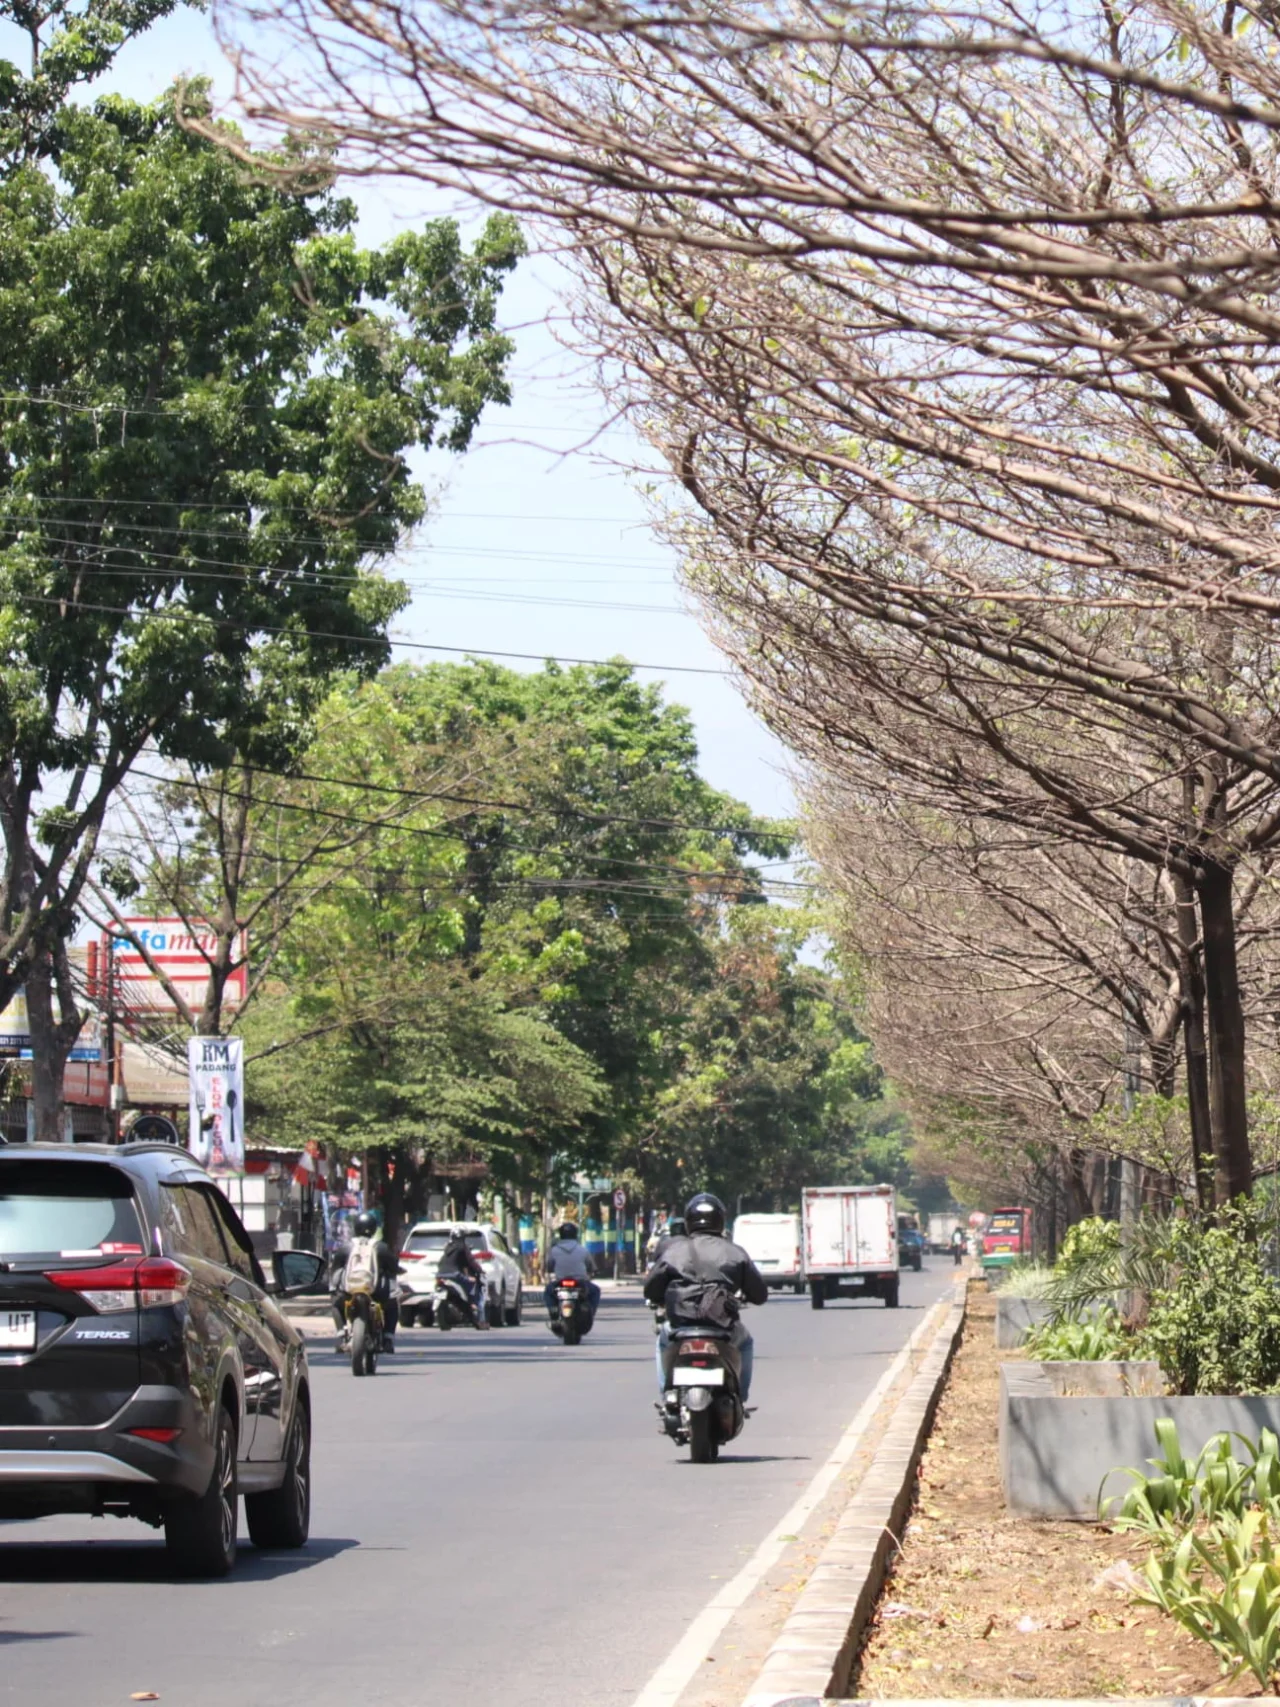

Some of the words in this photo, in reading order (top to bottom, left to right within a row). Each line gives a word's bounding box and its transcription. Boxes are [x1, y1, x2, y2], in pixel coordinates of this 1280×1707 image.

[203, 1044, 230, 1062] RM
[196, 1064, 237, 1072] PADANG
[76, 1331, 132, 1340] TERIOS
